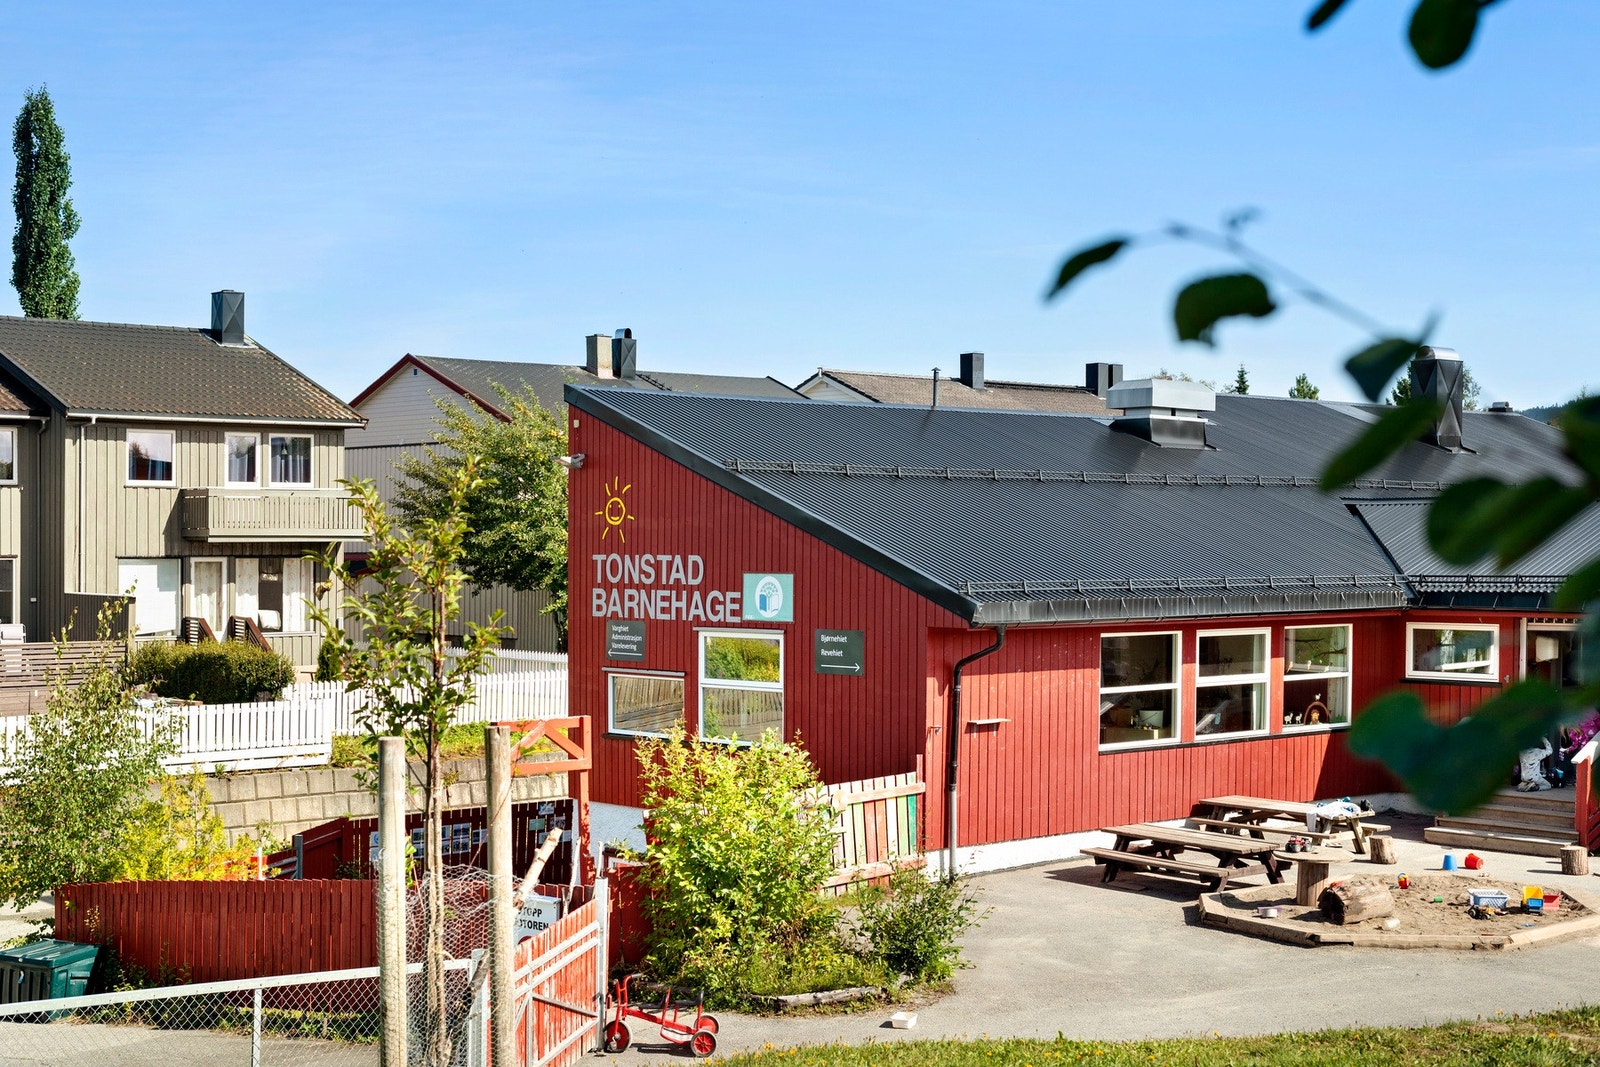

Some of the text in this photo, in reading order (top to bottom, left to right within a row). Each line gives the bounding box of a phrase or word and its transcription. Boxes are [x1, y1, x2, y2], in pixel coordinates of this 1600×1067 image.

[592, 553, 704, 586] TONSTAD
[592, 588, 741, 623] BARNEHAGE
[611, 633, 643, 643] Administrasjon
[820, 634, 848, 643] Bjørnehiet
[611, 642, 637, 652] Varelevering
[820, 648, 843, 656] Revehiet
[518, 906, 543, 917] TOPP
